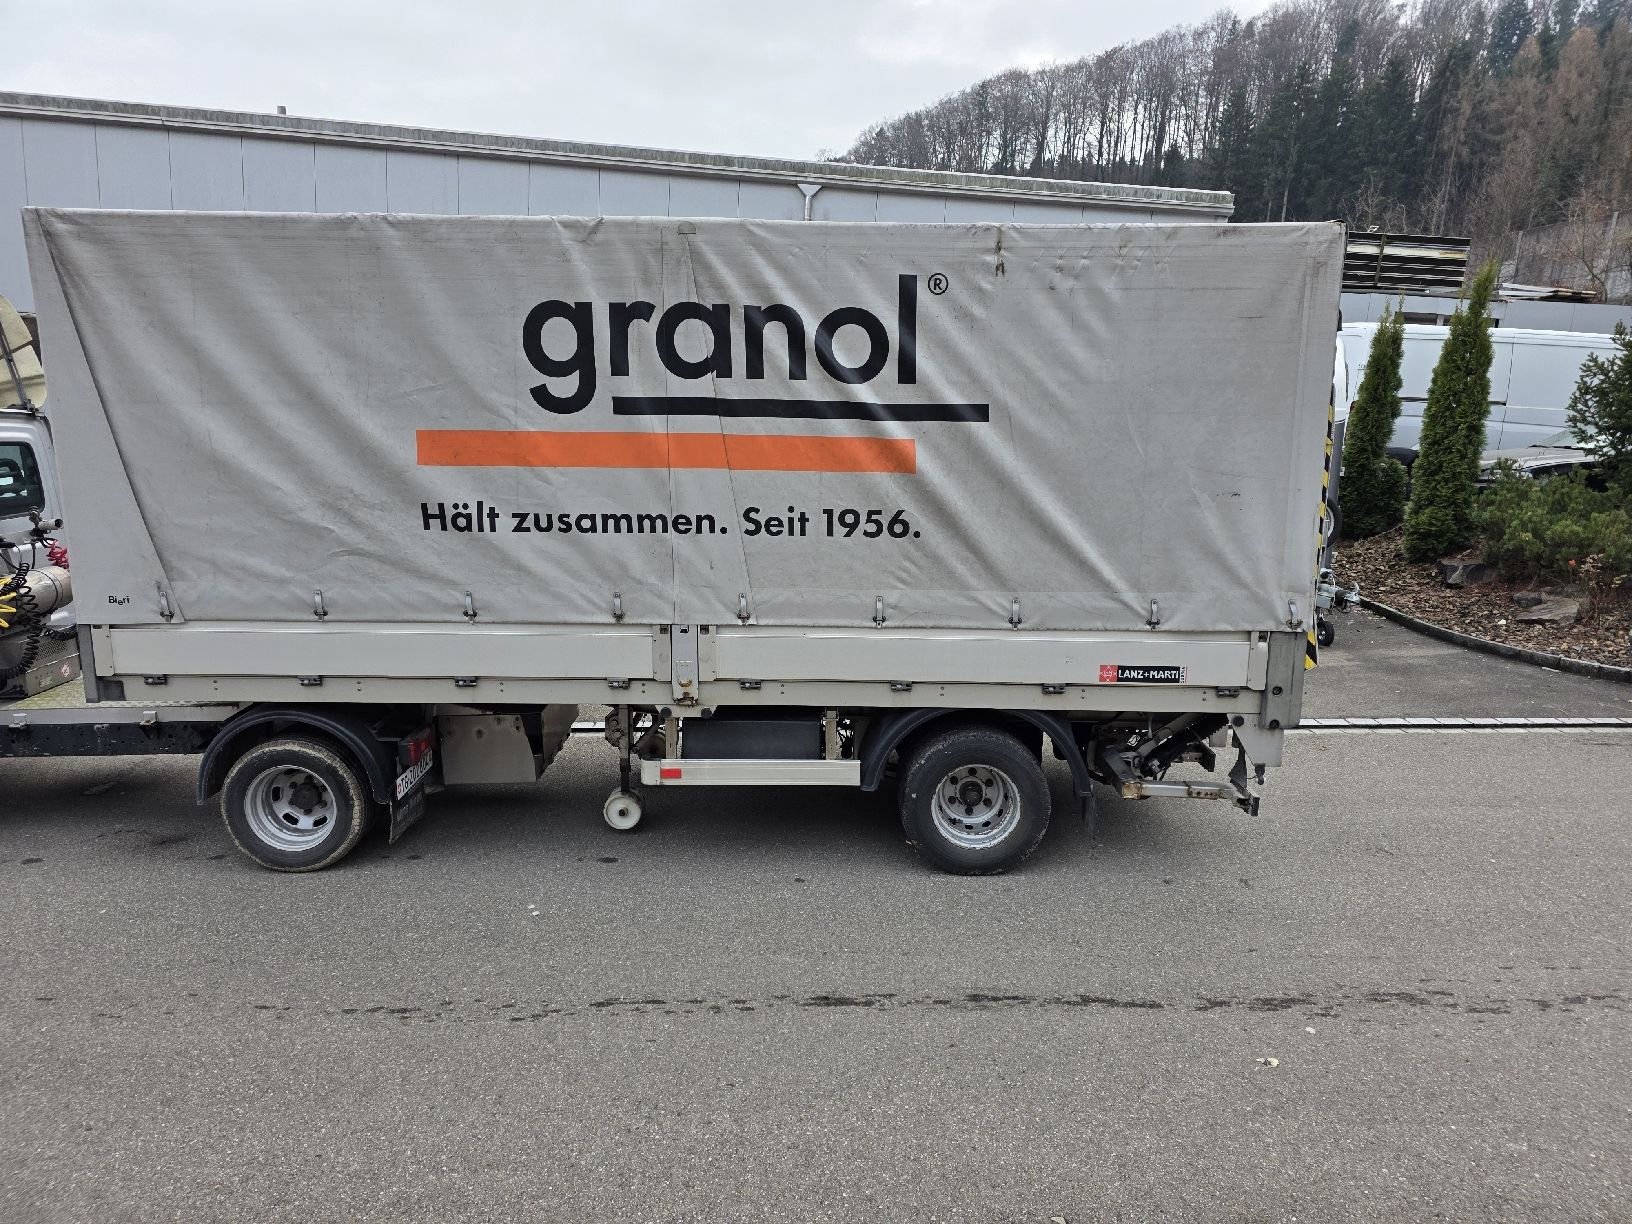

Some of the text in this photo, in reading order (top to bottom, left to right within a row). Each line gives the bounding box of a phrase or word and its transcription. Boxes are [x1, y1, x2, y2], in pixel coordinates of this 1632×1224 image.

[420, 500, 921, 539] Hält zusammen. Seit 1956.
[108, 595, 130, 606] Bieri
[1118, 669, 1179, 679] LANZ+MARTI
